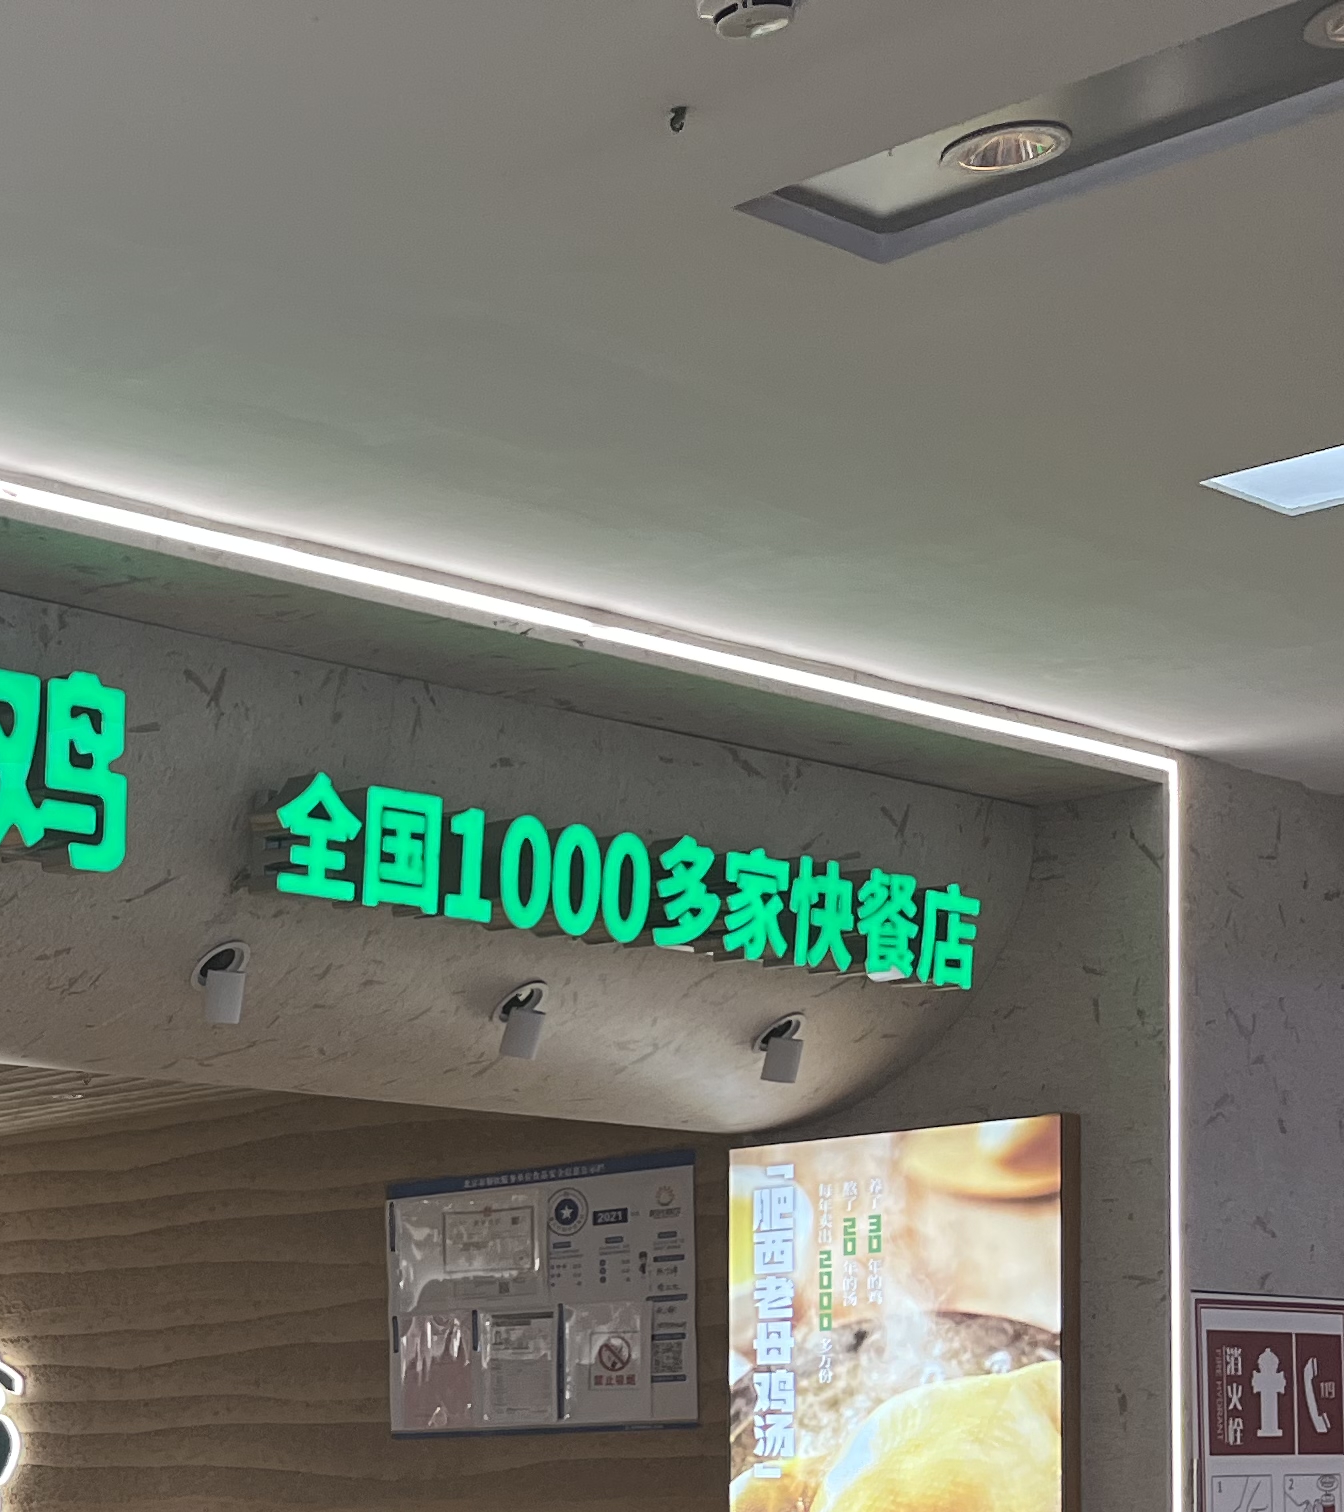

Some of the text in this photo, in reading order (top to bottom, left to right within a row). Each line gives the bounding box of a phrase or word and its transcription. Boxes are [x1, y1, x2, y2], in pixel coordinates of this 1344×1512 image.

[276, 772, 981, 990] 全国1000多家快餐店
[597, 1212, 623, 1224] 2021
[1215, 1348, 1224, 1440] FIRE HYDRANT
[1226, 1346, 1244, 1446] 消火栓
[1319, 1381, 1336, 1399] 119
[1288, 1478, 1295, 1490] 2
